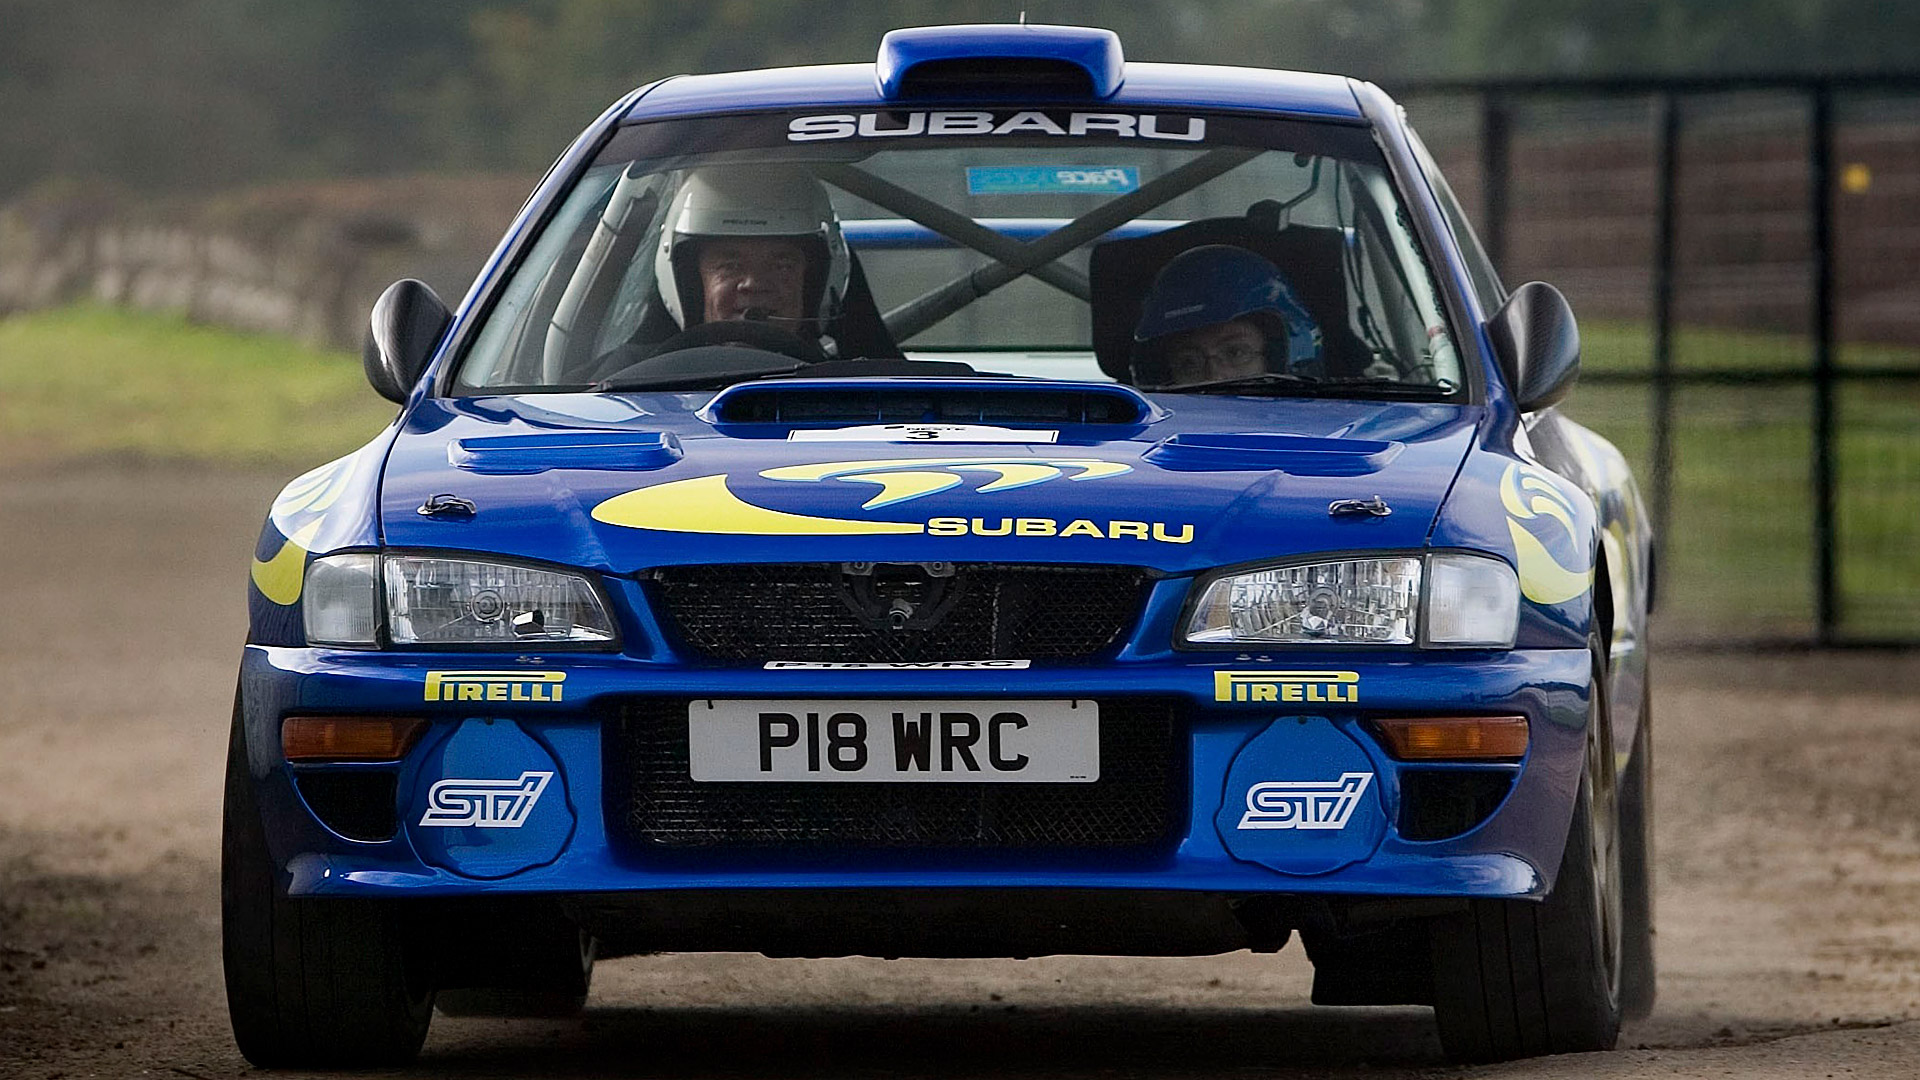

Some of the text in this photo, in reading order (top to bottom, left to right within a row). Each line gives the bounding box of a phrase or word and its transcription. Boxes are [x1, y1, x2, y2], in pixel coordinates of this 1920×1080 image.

[787, 111, 1206, 142] SUBARU
[906, 430, 940, 440] 3
[927, 517, 1195, 544] SUBARU
[889, 660, 1016, 668] WRC
[424, 671, 566, 702] PIRELLI
[1213, 670, 1360, 702] PIRELLI
[758, 712, 1029, 772] P18 WRC
